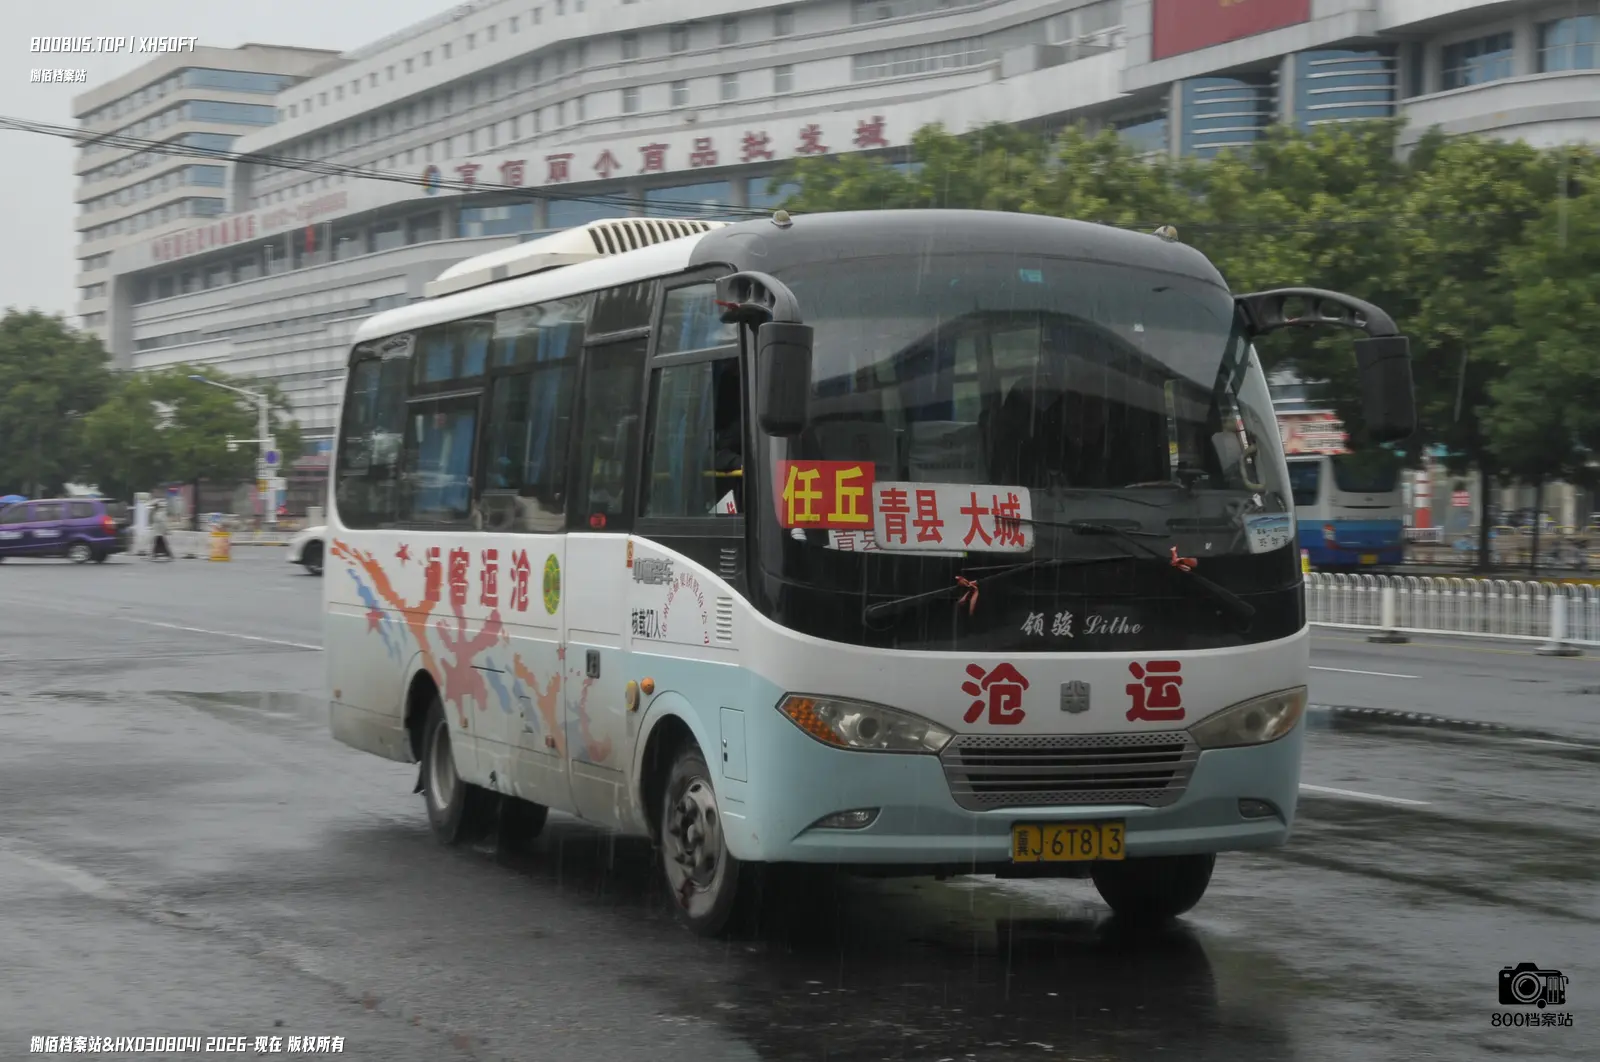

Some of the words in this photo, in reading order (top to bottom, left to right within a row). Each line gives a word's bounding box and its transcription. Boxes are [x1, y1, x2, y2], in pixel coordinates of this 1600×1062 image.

[782, 465, 868, 524] 任丘
[879, 488, 944, 544] 青县
[960, 492, 1025, 548] 大城
[1020, 611, 1075, 638] 领骏
[1082, 614, 1145, 636] Lithe
[961, 662, 1030, 725] 沧
[1126, 660, 1186, 722] 运
